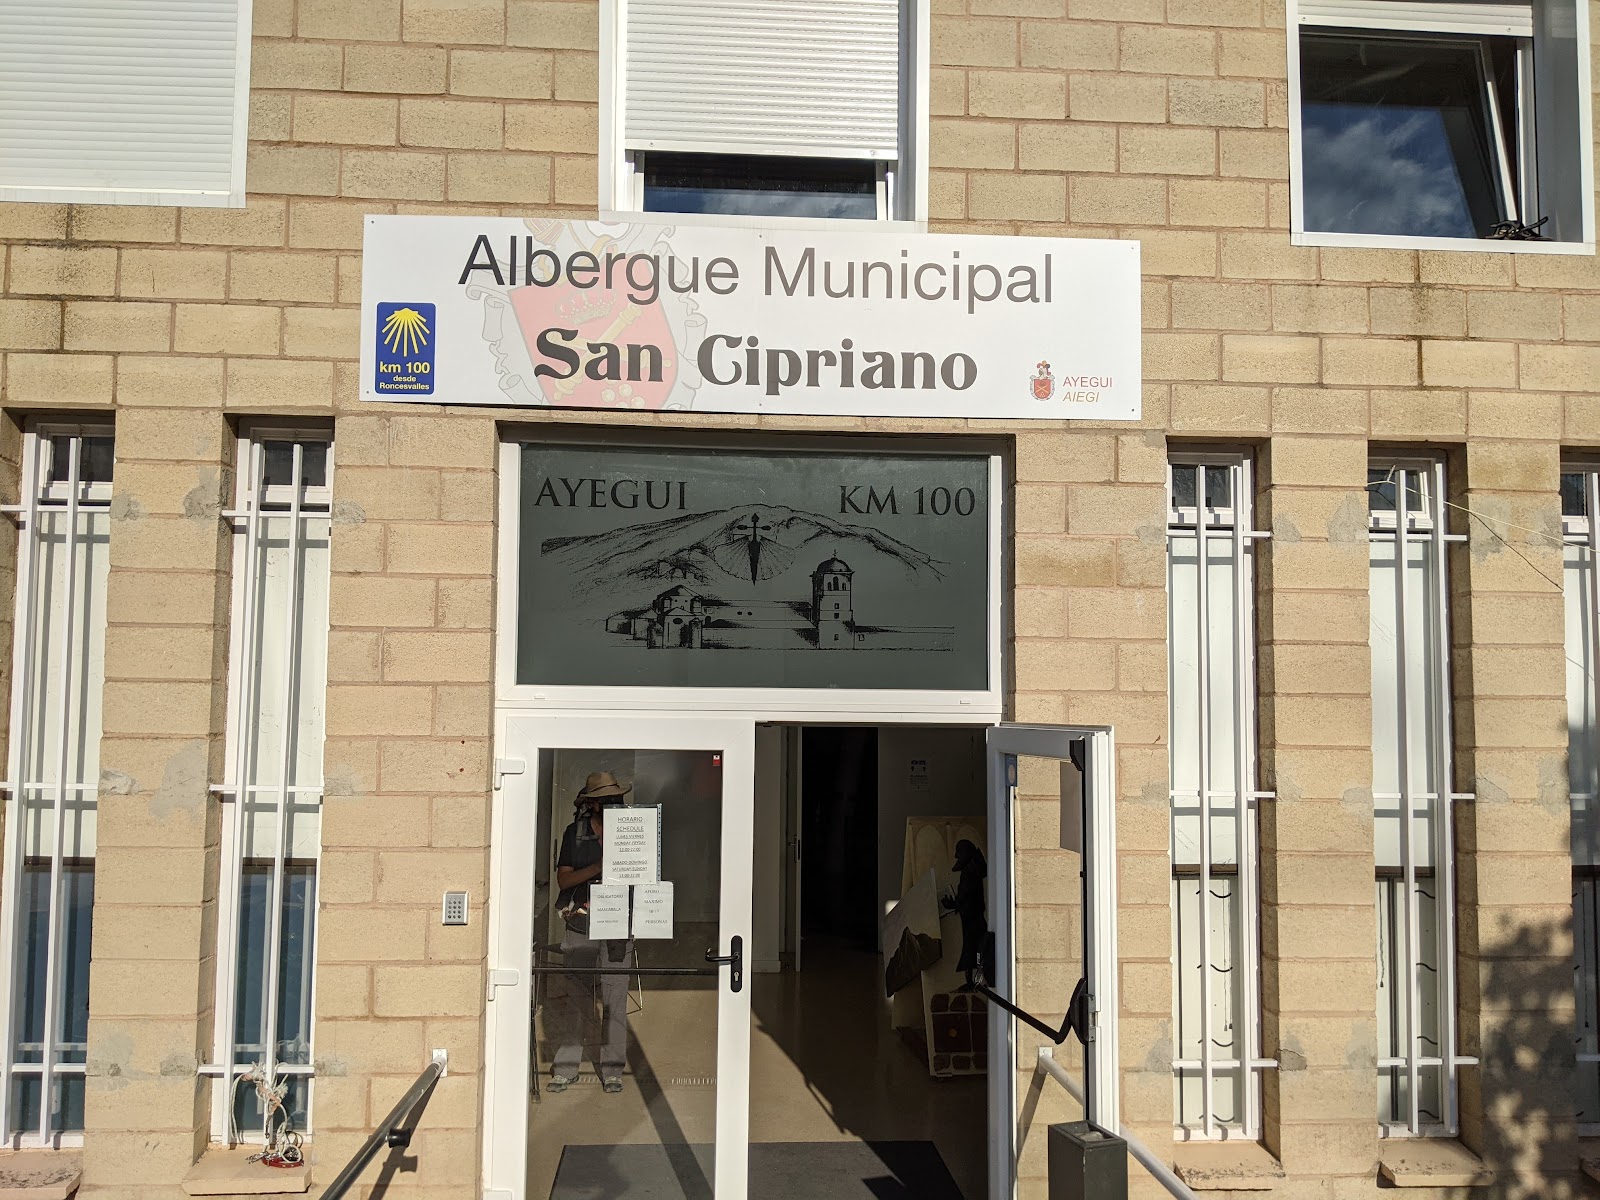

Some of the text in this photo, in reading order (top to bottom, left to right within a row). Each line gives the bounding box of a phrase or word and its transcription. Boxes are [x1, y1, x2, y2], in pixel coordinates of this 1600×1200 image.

[457, 233, 1053, 315] Albergue Municipal
[379, 361, 430, 374] km 100
[533, 327, 978, 396] San Cipriano
[392, 374, 417, 382] desde
[1062, 376, 1113, 388] AYEGUI
[379, 382, 430, 390] Roncesvalles
[1062, 391, 1100, 403] AIEGI
[534, 477, 689, 511] AYEGUI
[838, 485, 976, 517] KM 100
